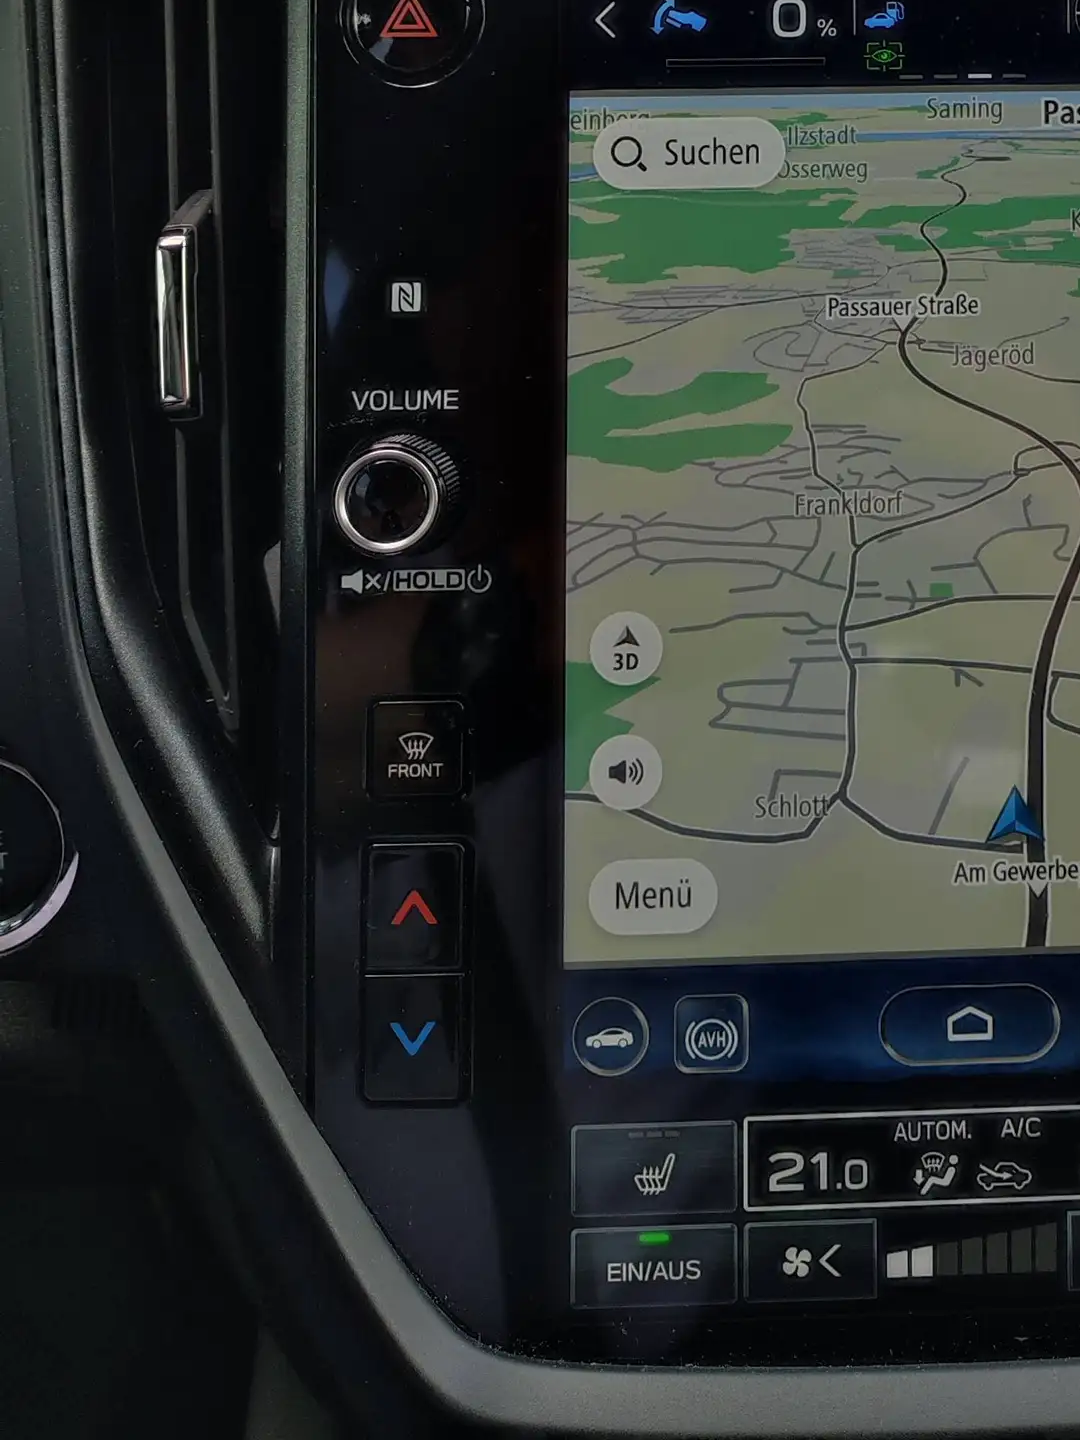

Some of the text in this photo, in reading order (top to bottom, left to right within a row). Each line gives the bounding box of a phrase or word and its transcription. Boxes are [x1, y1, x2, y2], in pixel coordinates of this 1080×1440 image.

[927, 98, 1002, 123] Saming
[665, 137, 760, 166] Suchen
[828, 295, 979, 317] Passauer Straße
[953, 343, 1034, 372] Jägeröd
[352, 389, 459, 411] VOLUME
[795, 491, 902, 516] Frankldorf
[613, 653, 639, 671] 3D
[388, 763, 443, 778] FRONT
[755, 794, 829, 818] Schlott
[953, 862, 986, 883] Am
[615, 879, 692, 910] Menü
[698, 1031, 727, 1048] AVH
[894, 1118, 1041, 1141] AUTOM. A/C
[768, 1151, 868, 1191] 21.0
[607, 1261, 701, 1282] EIN/AUS
